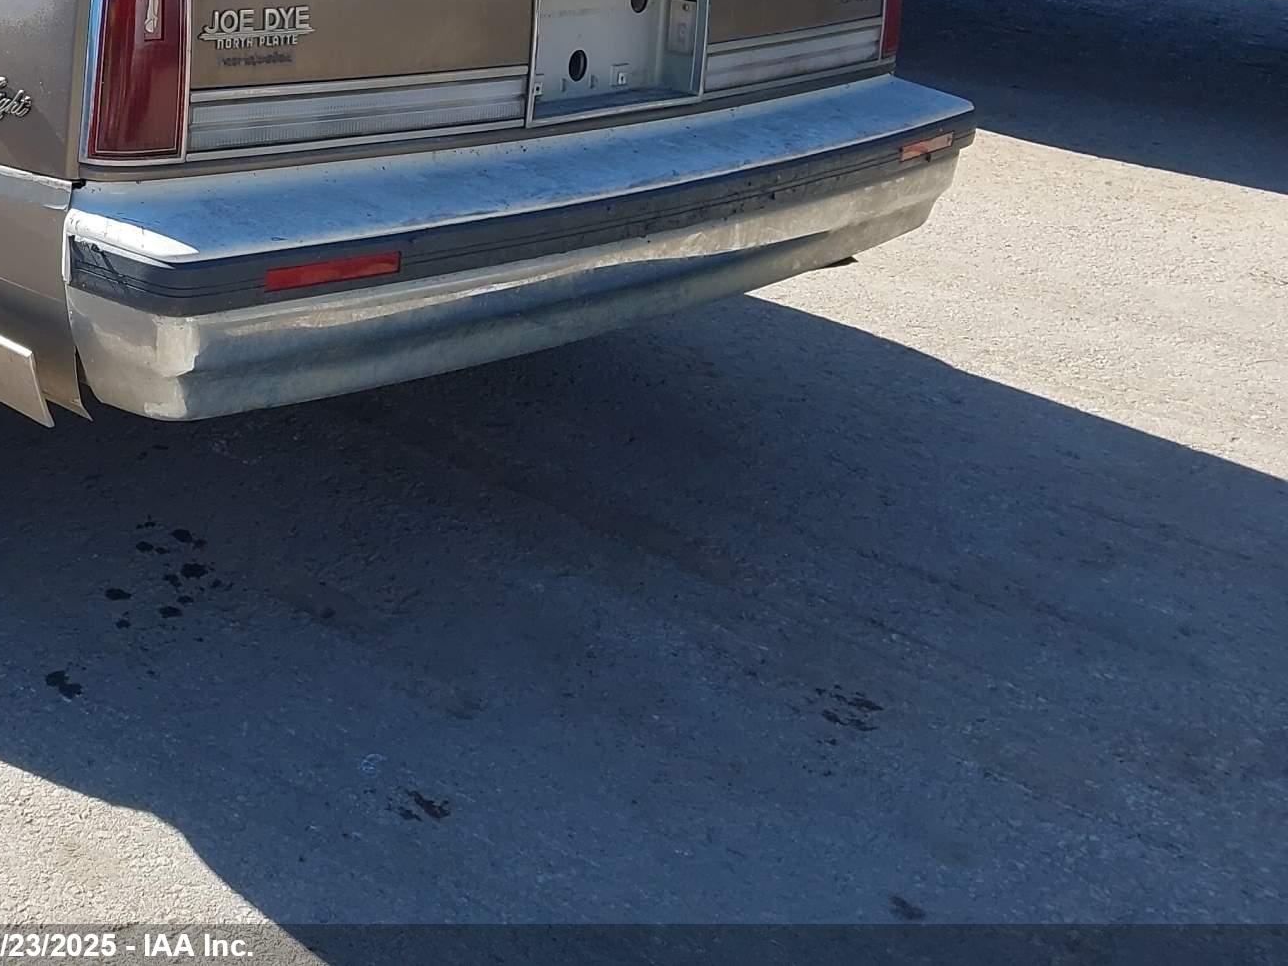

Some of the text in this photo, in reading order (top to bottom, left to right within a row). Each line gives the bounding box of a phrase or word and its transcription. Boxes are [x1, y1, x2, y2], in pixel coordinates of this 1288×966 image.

[203, 6, 311, 34] JOE DYE
[216, 34, 299, 50] NORTH PLATTE
